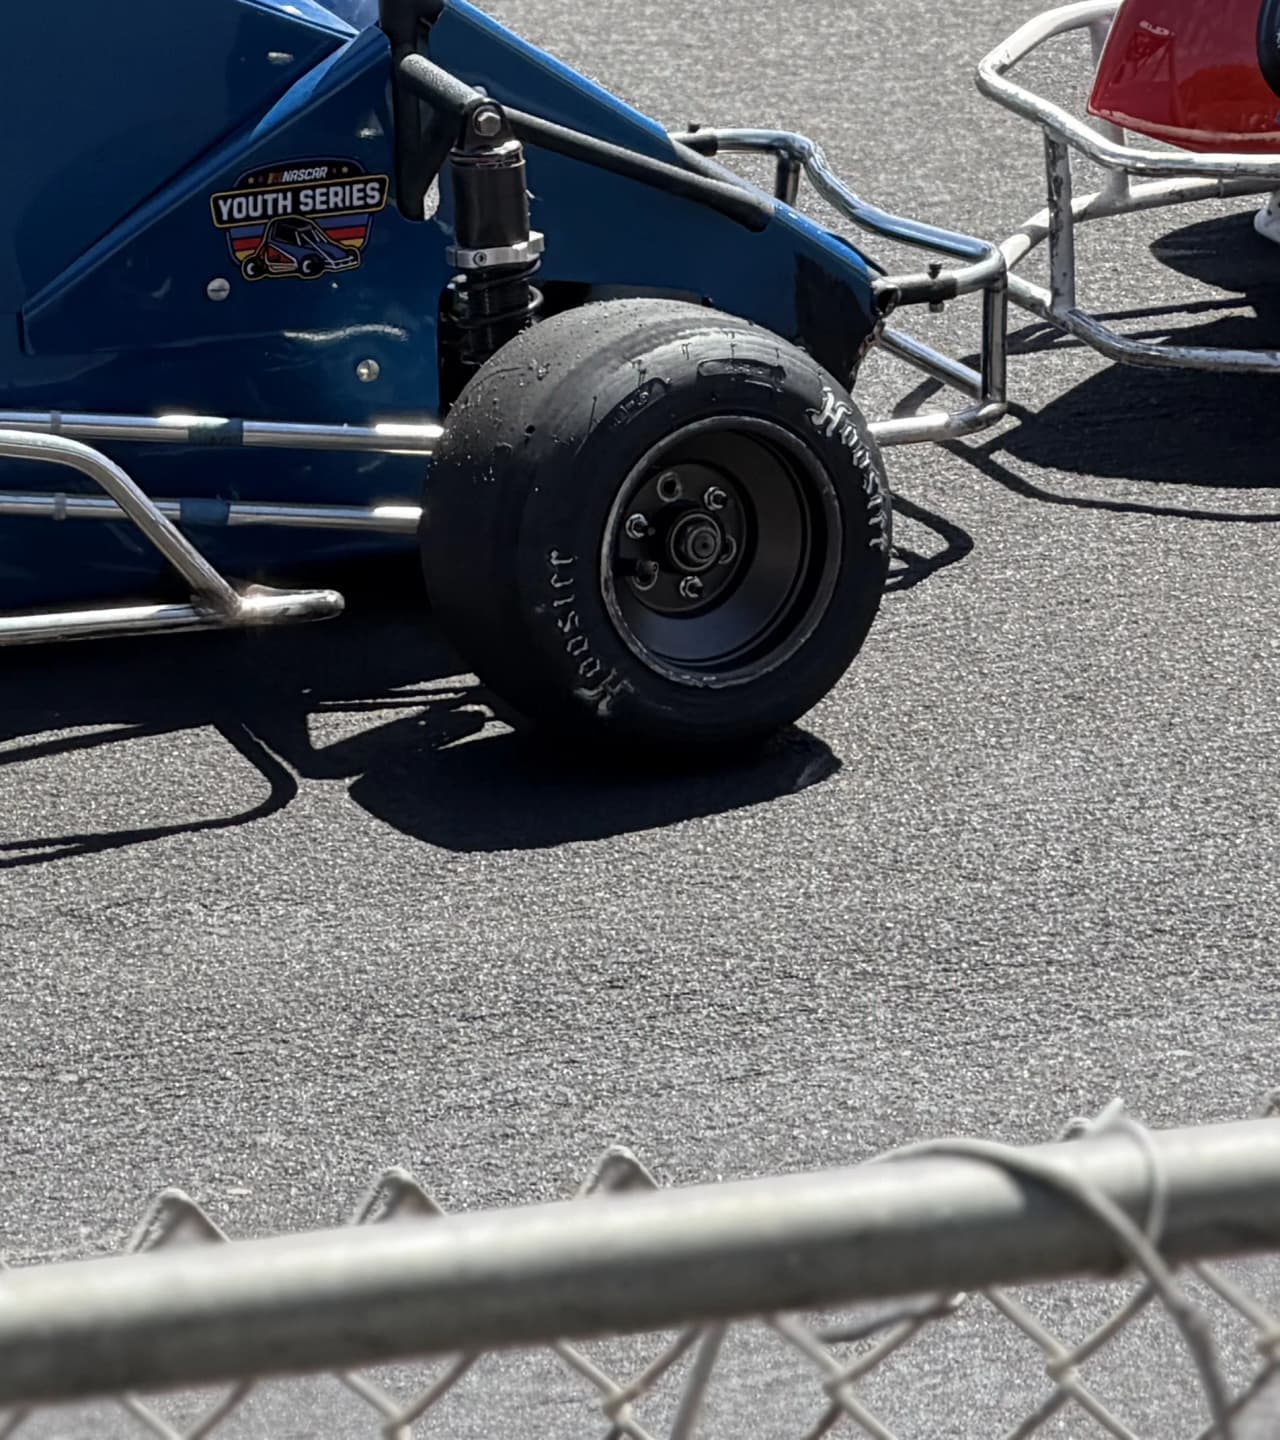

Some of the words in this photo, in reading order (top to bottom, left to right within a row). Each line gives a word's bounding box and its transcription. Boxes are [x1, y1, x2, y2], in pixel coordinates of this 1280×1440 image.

[282, 166, 328, 183] NASCAR
[218, 192, 292, 221] YOUTH
[299, 182, 380, 212] SERIES
